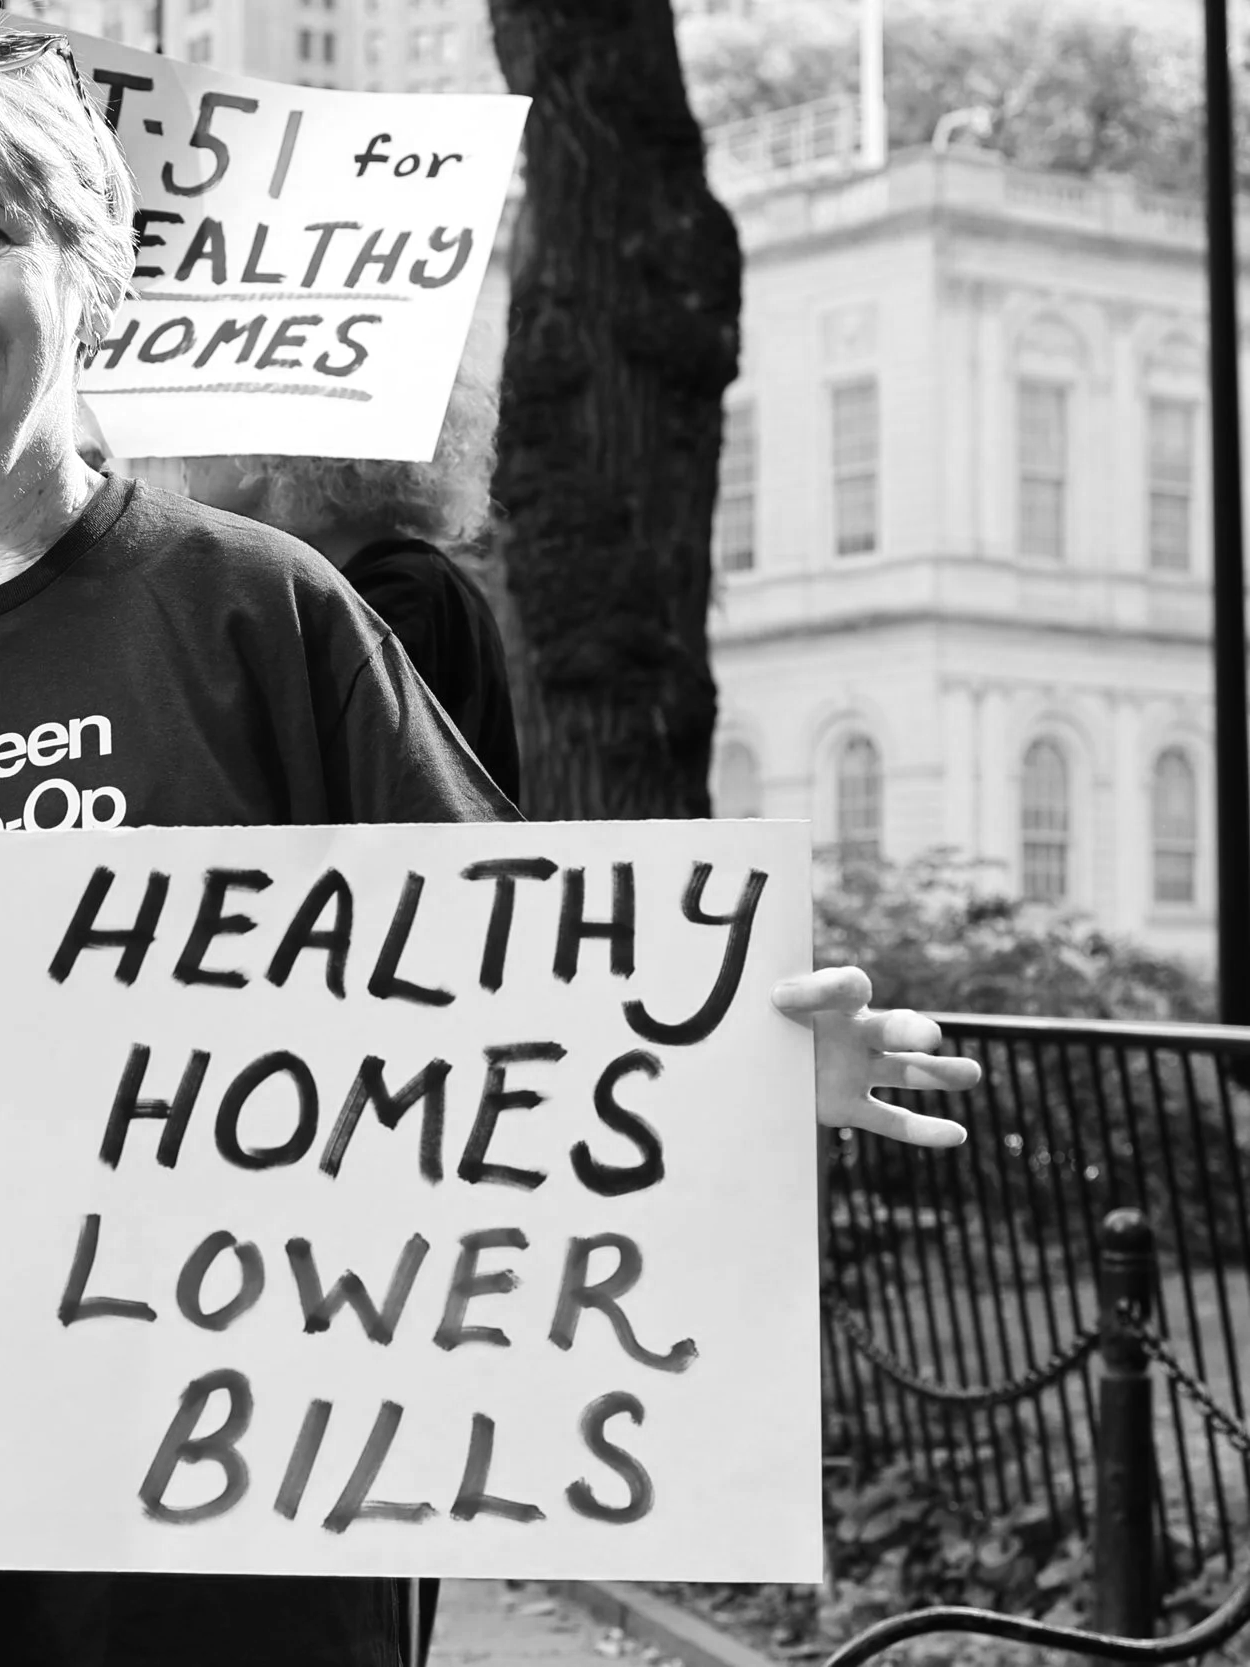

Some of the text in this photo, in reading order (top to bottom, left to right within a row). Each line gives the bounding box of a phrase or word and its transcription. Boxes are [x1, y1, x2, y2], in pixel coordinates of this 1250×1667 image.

[354, 132, 462, 179] for
[132, 208, 474, 289] EALTHY
[82, 313, 382, 377] HOMES
[47, 857, 769, 1046] HEALTHY
[99, 1041, 665, 1197] HOMES
[57, 1213, 700, 1374] LOWER
[138, 1368, 656, 1534] BILLS
